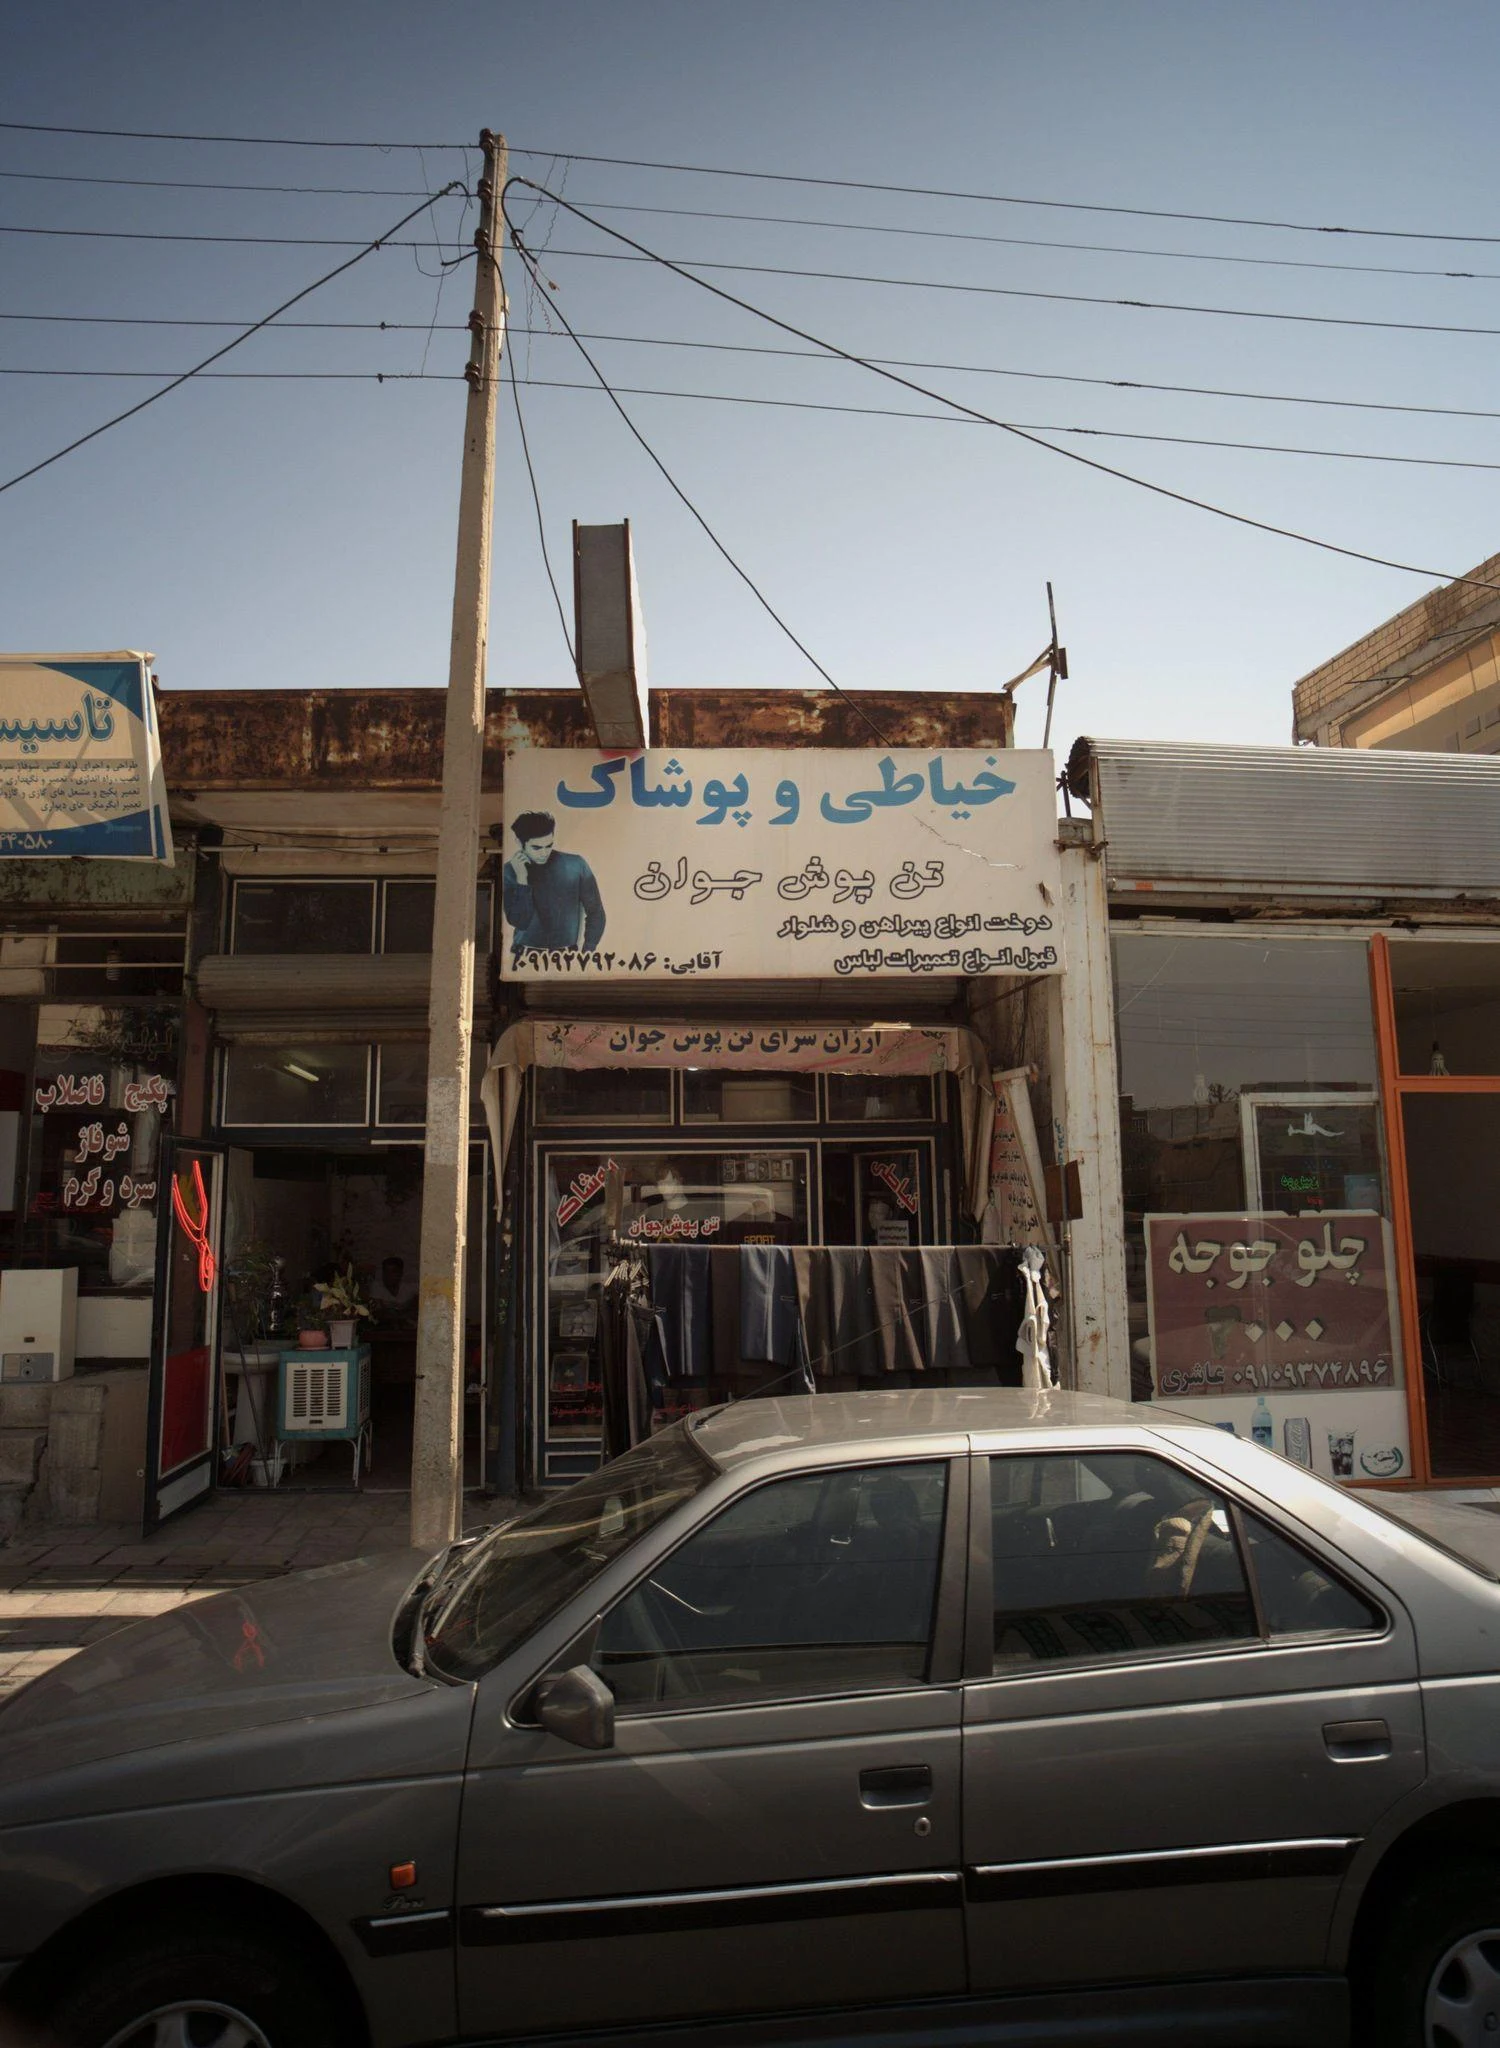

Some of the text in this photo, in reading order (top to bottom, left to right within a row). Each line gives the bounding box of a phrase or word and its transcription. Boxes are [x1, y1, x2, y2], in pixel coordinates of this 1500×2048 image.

[557, 754, 1017, 829] خیاطی و پوشاک
[634, 856, 945, 905] تن پوش جوان
[777, 913, 1052, 940] دوخت انواع پیراهن و شلوار
[517, 951, 657, 972] ۰۹۱۹۲۷۹۲۰۸۶
[833, 946, 1057, 975] قبول انواع تعمیرات لباس
[609, 1025, 667, 1053] جوان
[35, 1073, 168, 1114] پکیج فاضلاب
[74, 1121, 131, 1163] شوفاژ
[63, 1166, 102, 1208] گرم
[99, 1179, 114, 1207] و
[870, 1161, 920, 1214] خیاطی
[628, 1213, 720, 1239] تن پوش جوان
[1168, 1221, 1367, 1290] چلو جوجه
[1233, 1359, 1388, 1388] ۰۹۱۰۹۳۷۴۸۹۶
